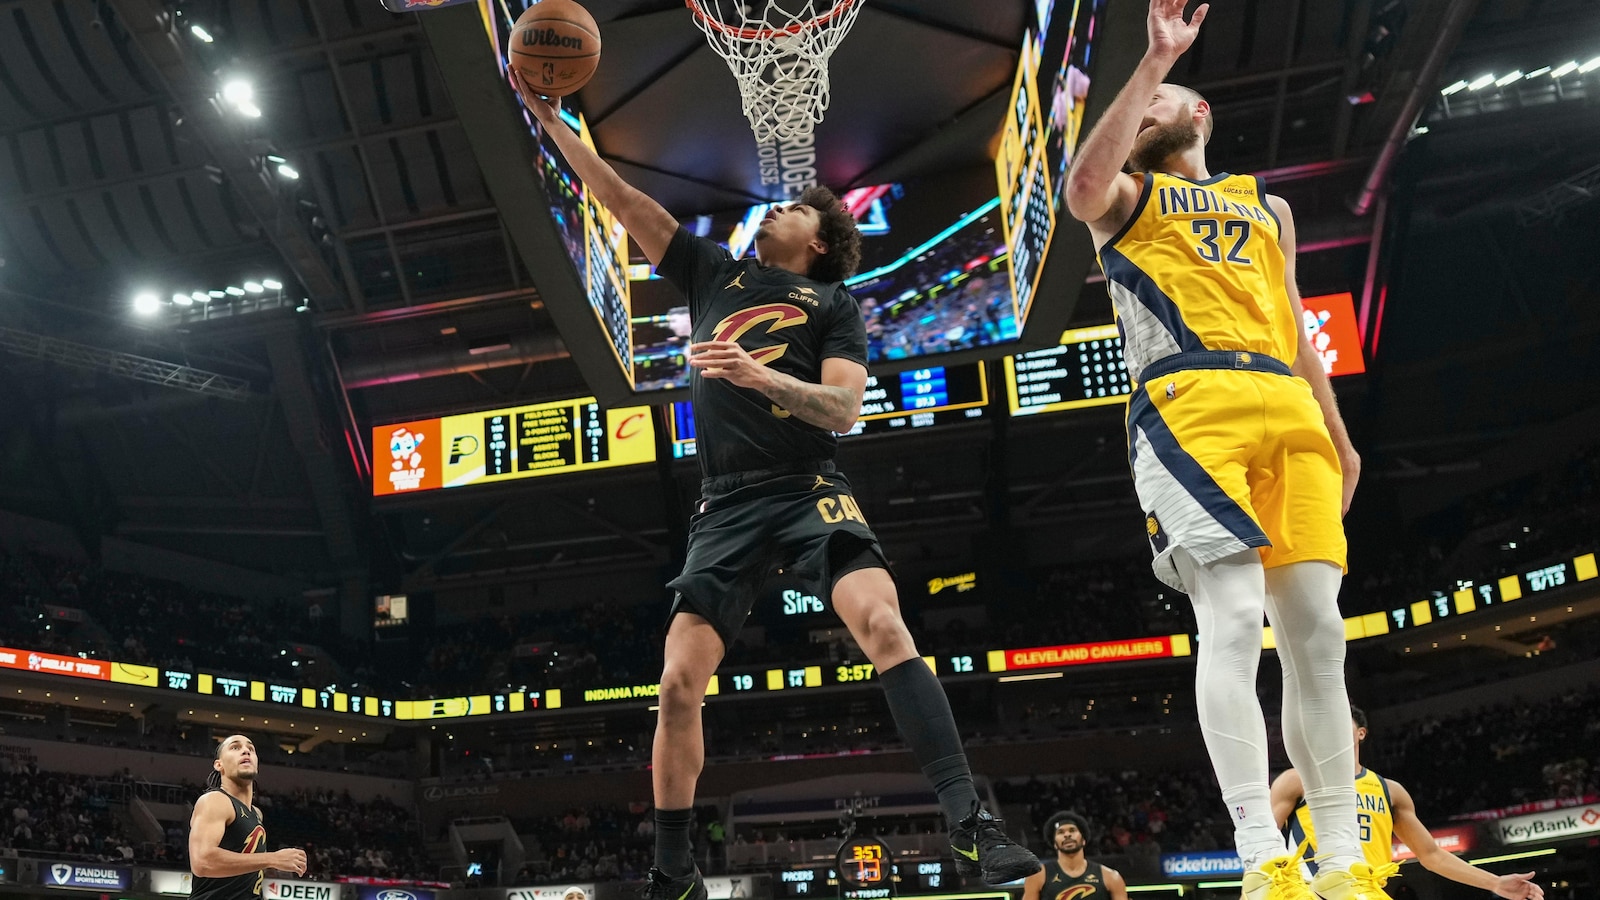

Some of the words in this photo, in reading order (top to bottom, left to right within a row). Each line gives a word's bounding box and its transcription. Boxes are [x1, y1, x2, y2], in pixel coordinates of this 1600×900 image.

[522, 28, 582, 51] Wilson
[1223, 186, 1243, 195] LUCAS
[1243, 188, 1255, 196] OIL
[1158, 186, 1270, 227] INDIANA
[1190, 218, 1252, 265] 32
[788, 291, 819, 307] CLIFFS
[1013, 645, 1088, 666] CLEVELAND
[1091, 640, 1164, 660] CAVALIERS
[951, 656, 974, 672] 12
[836, 663, 875, 683] 3:57
[733, 675, 753, 691] 19
[789, 676, 804, 688] 14
[583, 686, 632, 702] INDIANA
[444, 786, 500, 798] LEXUS
[1356, 792, 1386, 815] ANA
[1357, 813, 1371, 842] 6
[1502, 815, 1579, 841] KeyBank
[853, 844, 882, 861] 3:57
[74, 866, 120, 879] FANDUEL
[74, 876, 95, 884] SPORTS
[95, 877, 120, 886] NETWORK
[782, 870, 814, 883] PACERS
[918, 863, 942, 875] CAVS
[280, 883, 331, 900] DEEM
[796, 882, 808, 894] 19
[929, 874, 941, 887] 12
[856, 888, 890, 899] TISSOT
